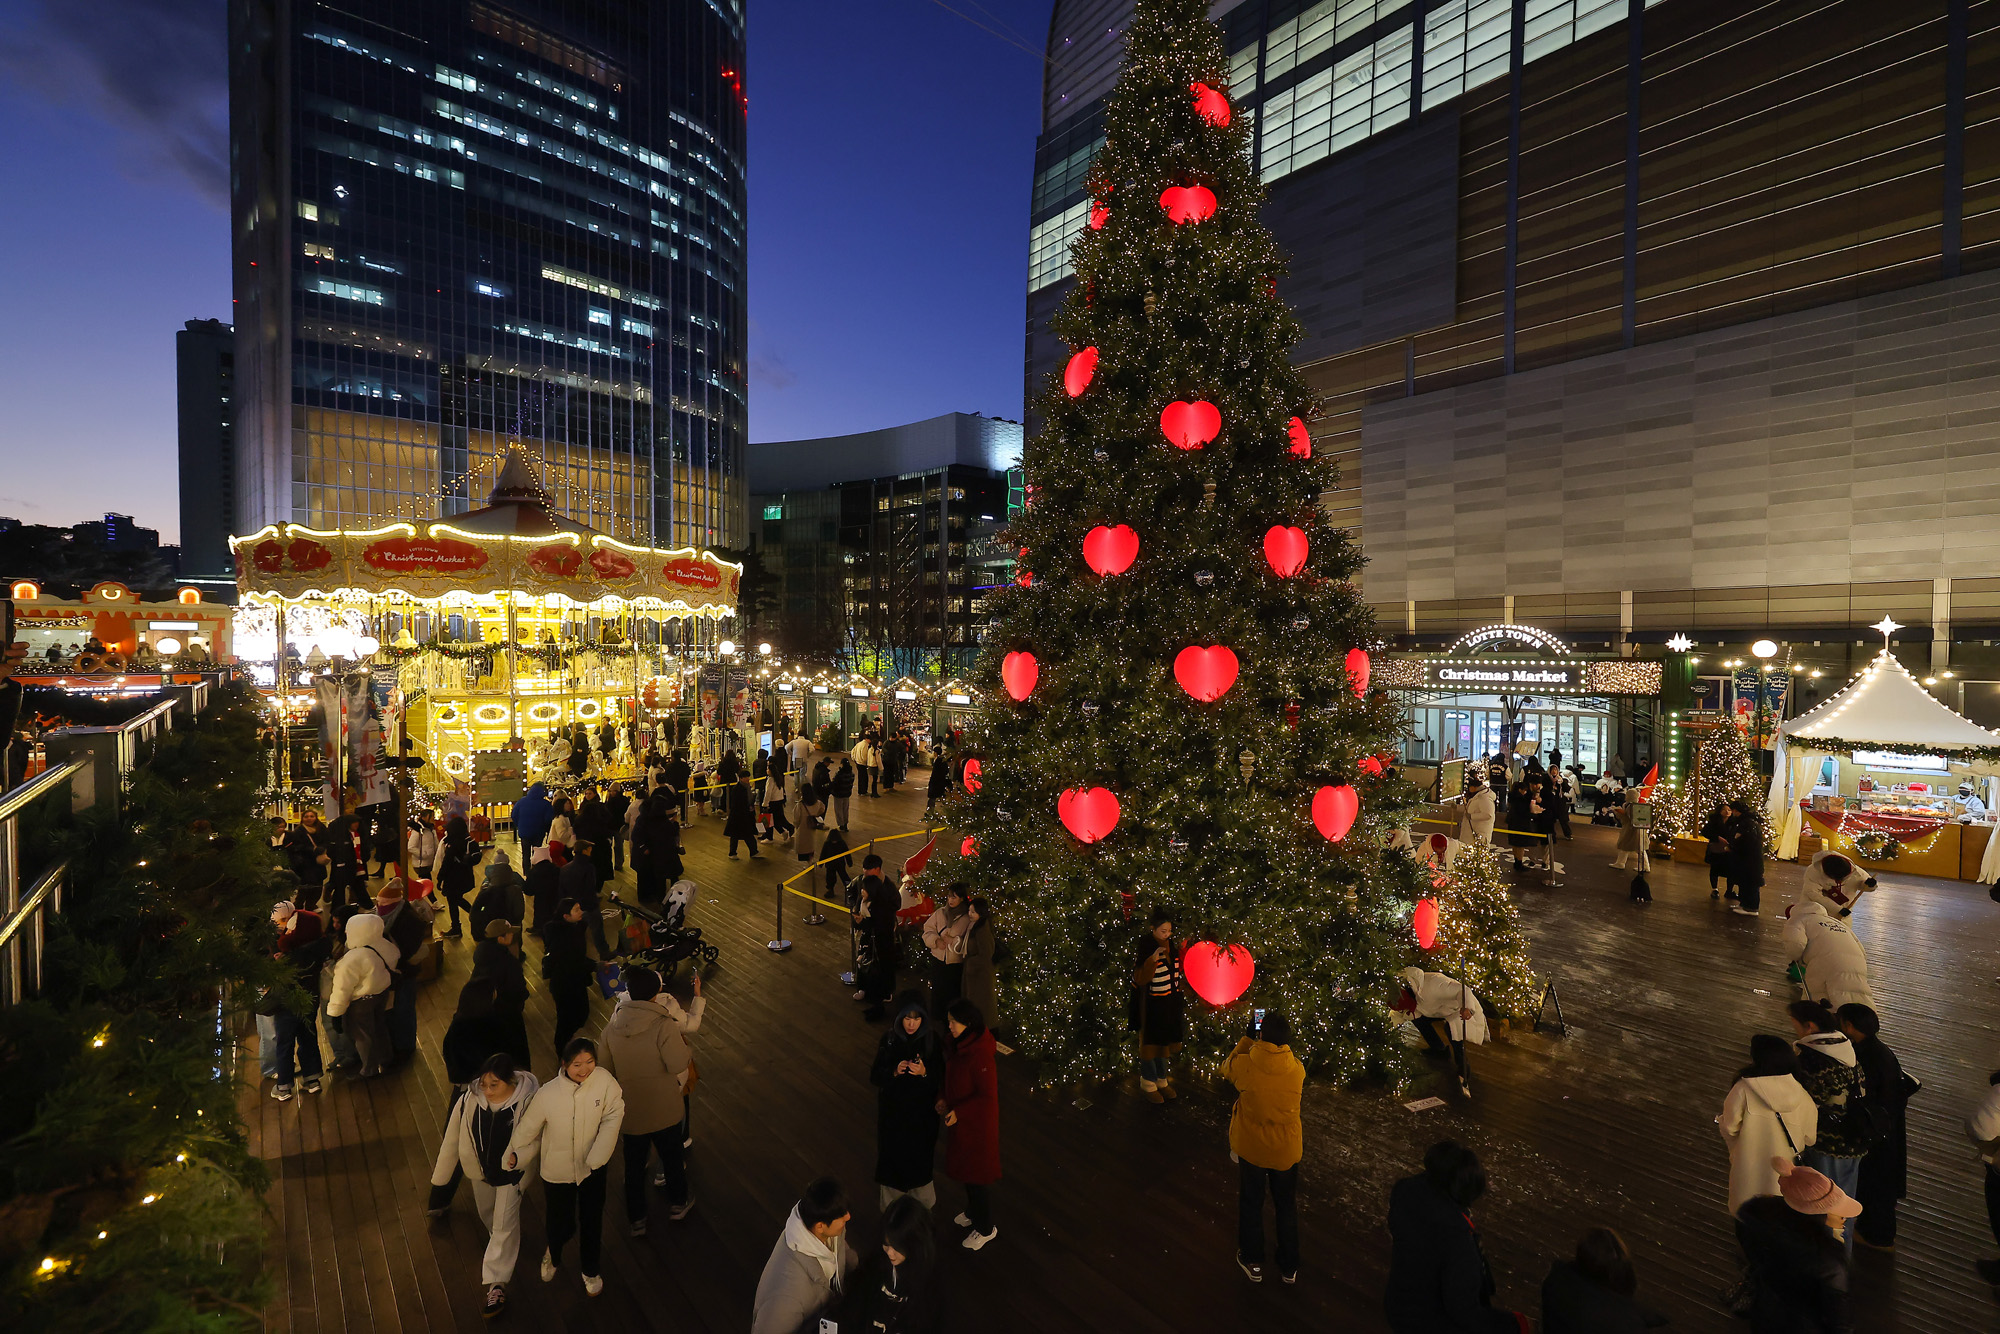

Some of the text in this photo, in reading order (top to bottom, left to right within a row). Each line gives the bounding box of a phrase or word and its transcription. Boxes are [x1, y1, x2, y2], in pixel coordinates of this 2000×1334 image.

[383, 551, 467, 564] Christmas Market
[1465, 629, 1544, 649] LOTTE TOWN
[1438, 668, 1568, 683] Christmas Market
